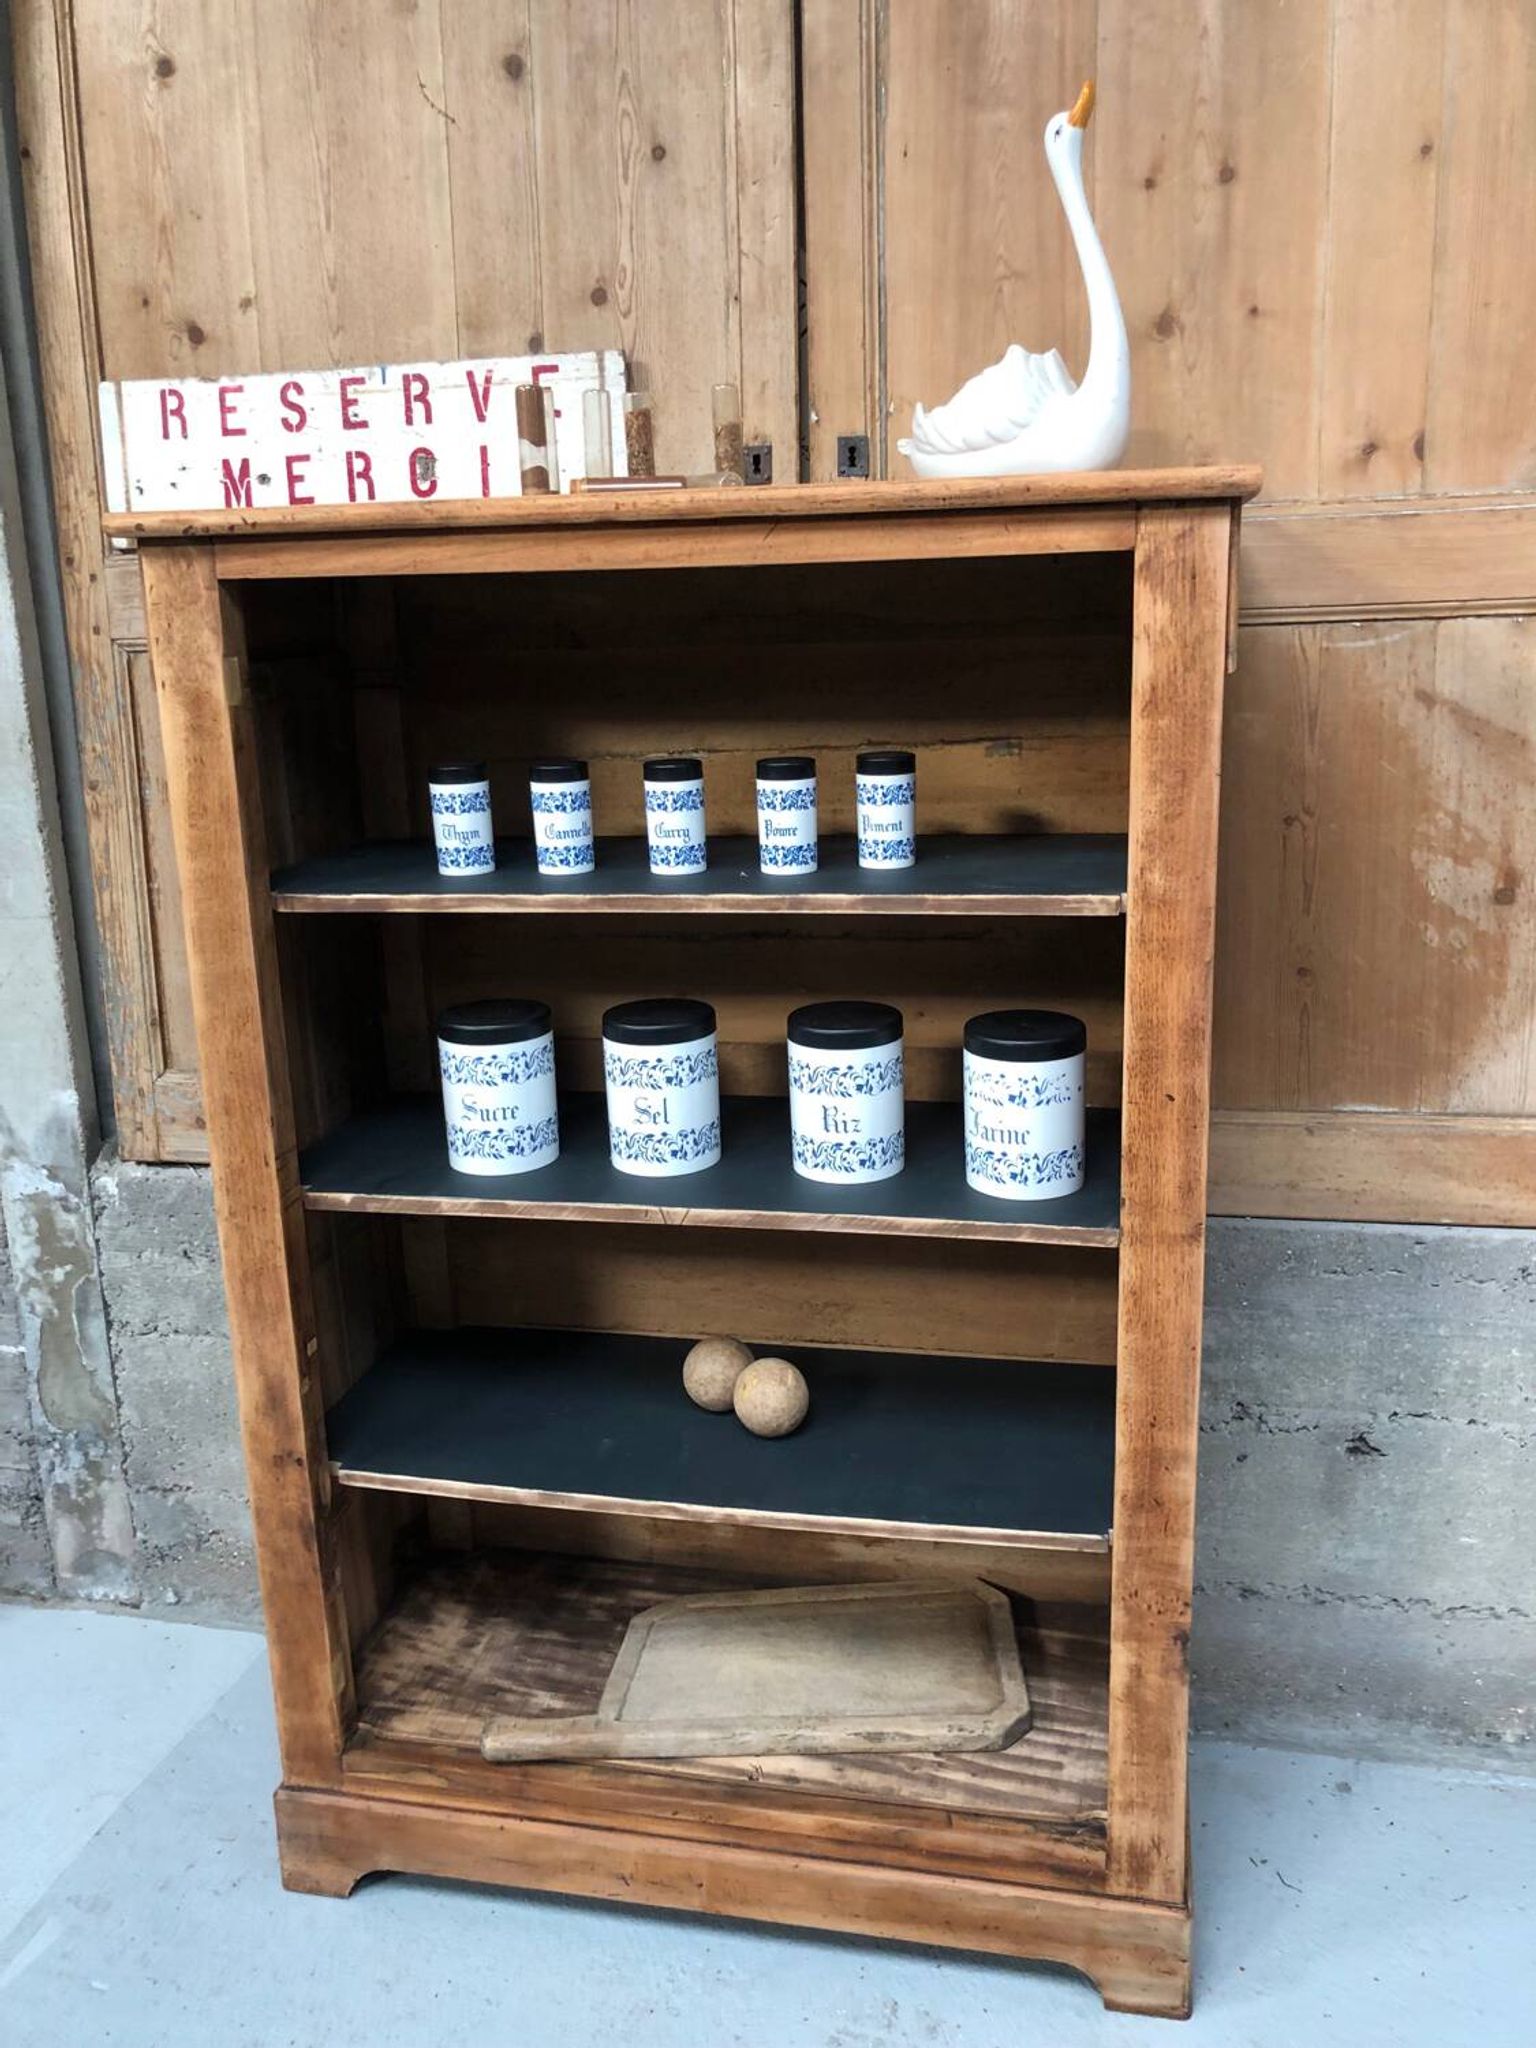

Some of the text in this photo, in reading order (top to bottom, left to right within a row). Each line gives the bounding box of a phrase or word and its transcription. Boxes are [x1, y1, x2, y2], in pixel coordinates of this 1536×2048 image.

[221, 444, 491, 508] MERCI
[442, 824, 481, 846] Thym
[654, 821, 691, 842] Curry
[861, 814, 903, 834] Piment
[461, 1093, 520, 1122] Sucre
[633, 1096, 671, 1125] Sel
[821, 1104, 862, 1134] Riz
[968, 1106, 1031, 1146] Farine
